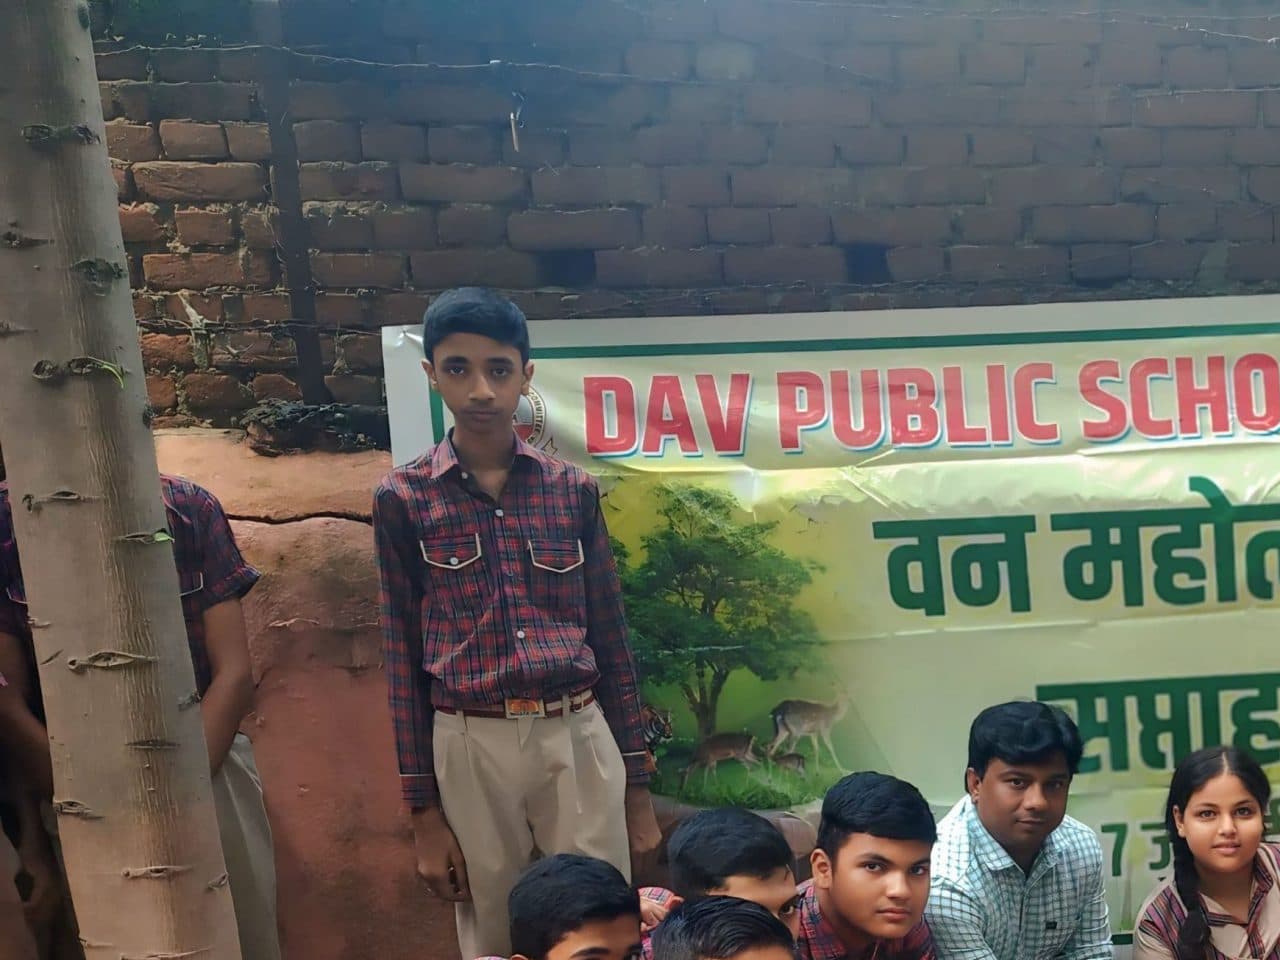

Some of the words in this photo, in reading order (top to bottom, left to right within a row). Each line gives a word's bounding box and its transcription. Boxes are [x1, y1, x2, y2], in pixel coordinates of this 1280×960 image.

[583, 373, 751, 457] DAV
[776, 362, 1059, 453] PUBLIC
[872, 514, 1036, 616] वन
